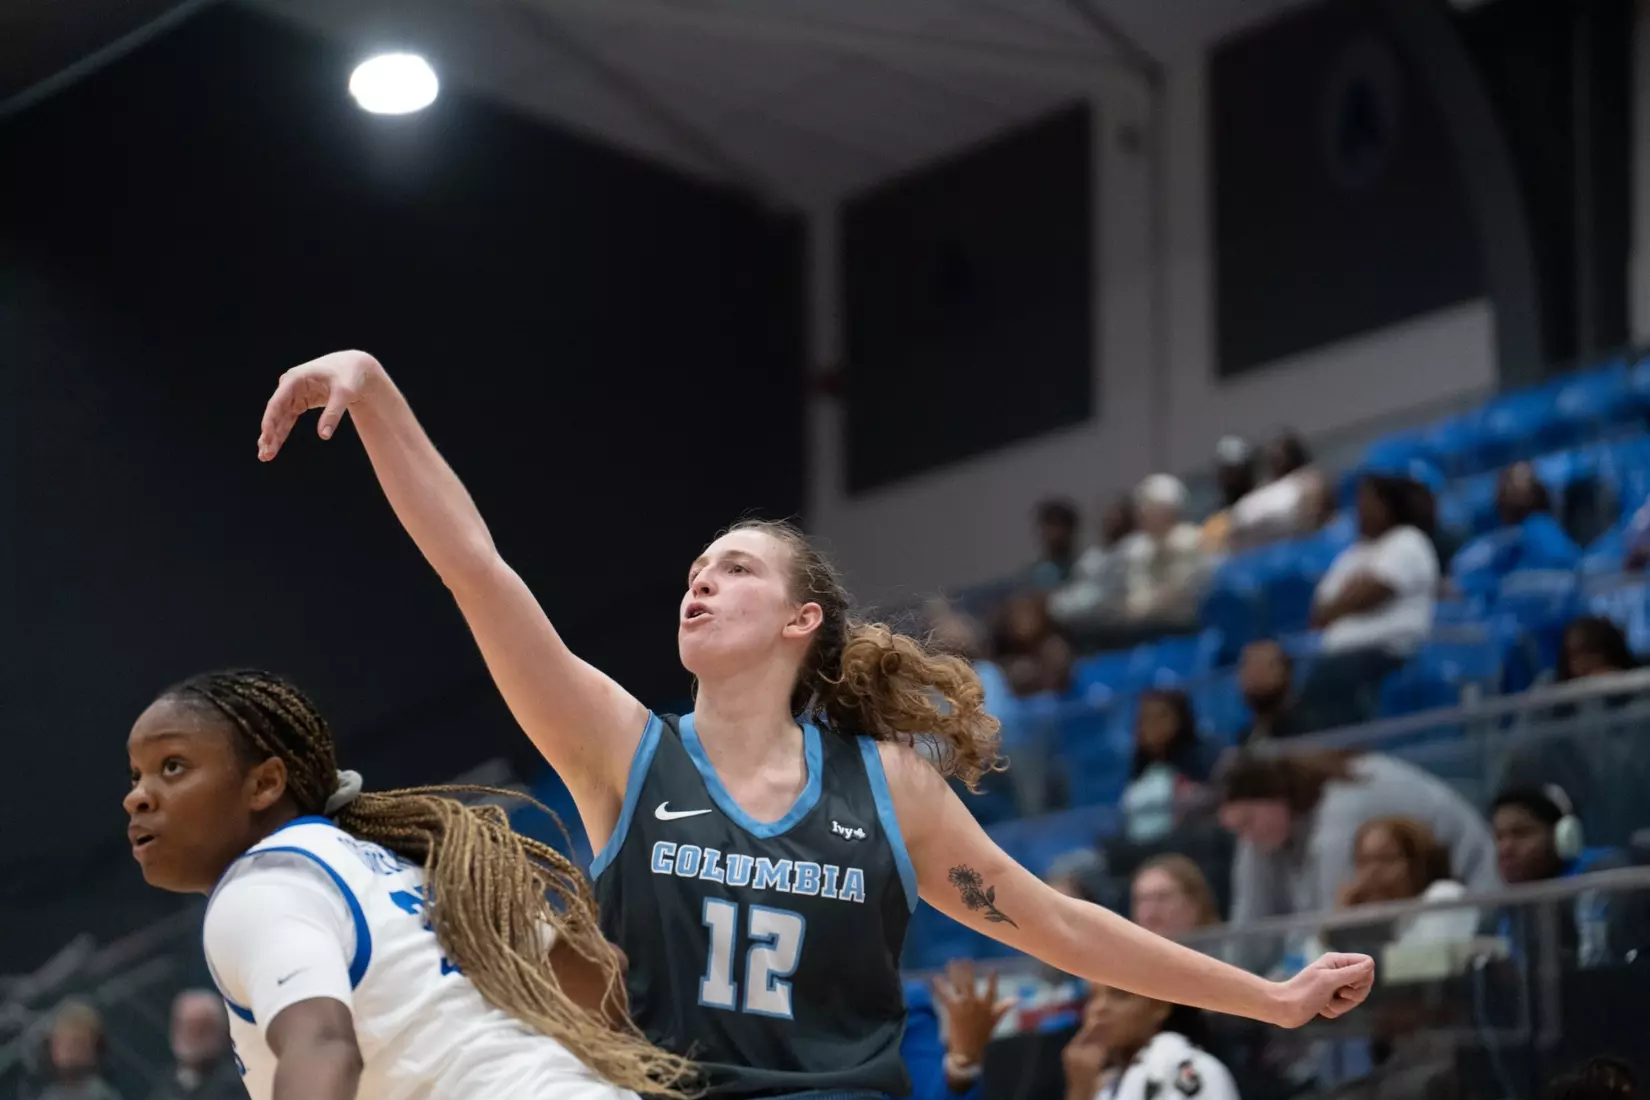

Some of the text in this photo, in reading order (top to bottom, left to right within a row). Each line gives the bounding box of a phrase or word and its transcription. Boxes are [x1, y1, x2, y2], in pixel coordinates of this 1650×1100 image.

[832, 820, 853, 839] Ivy
[651, 841, 865, 903] COLUMBIA
[697, 896, 807, 1020] 12
